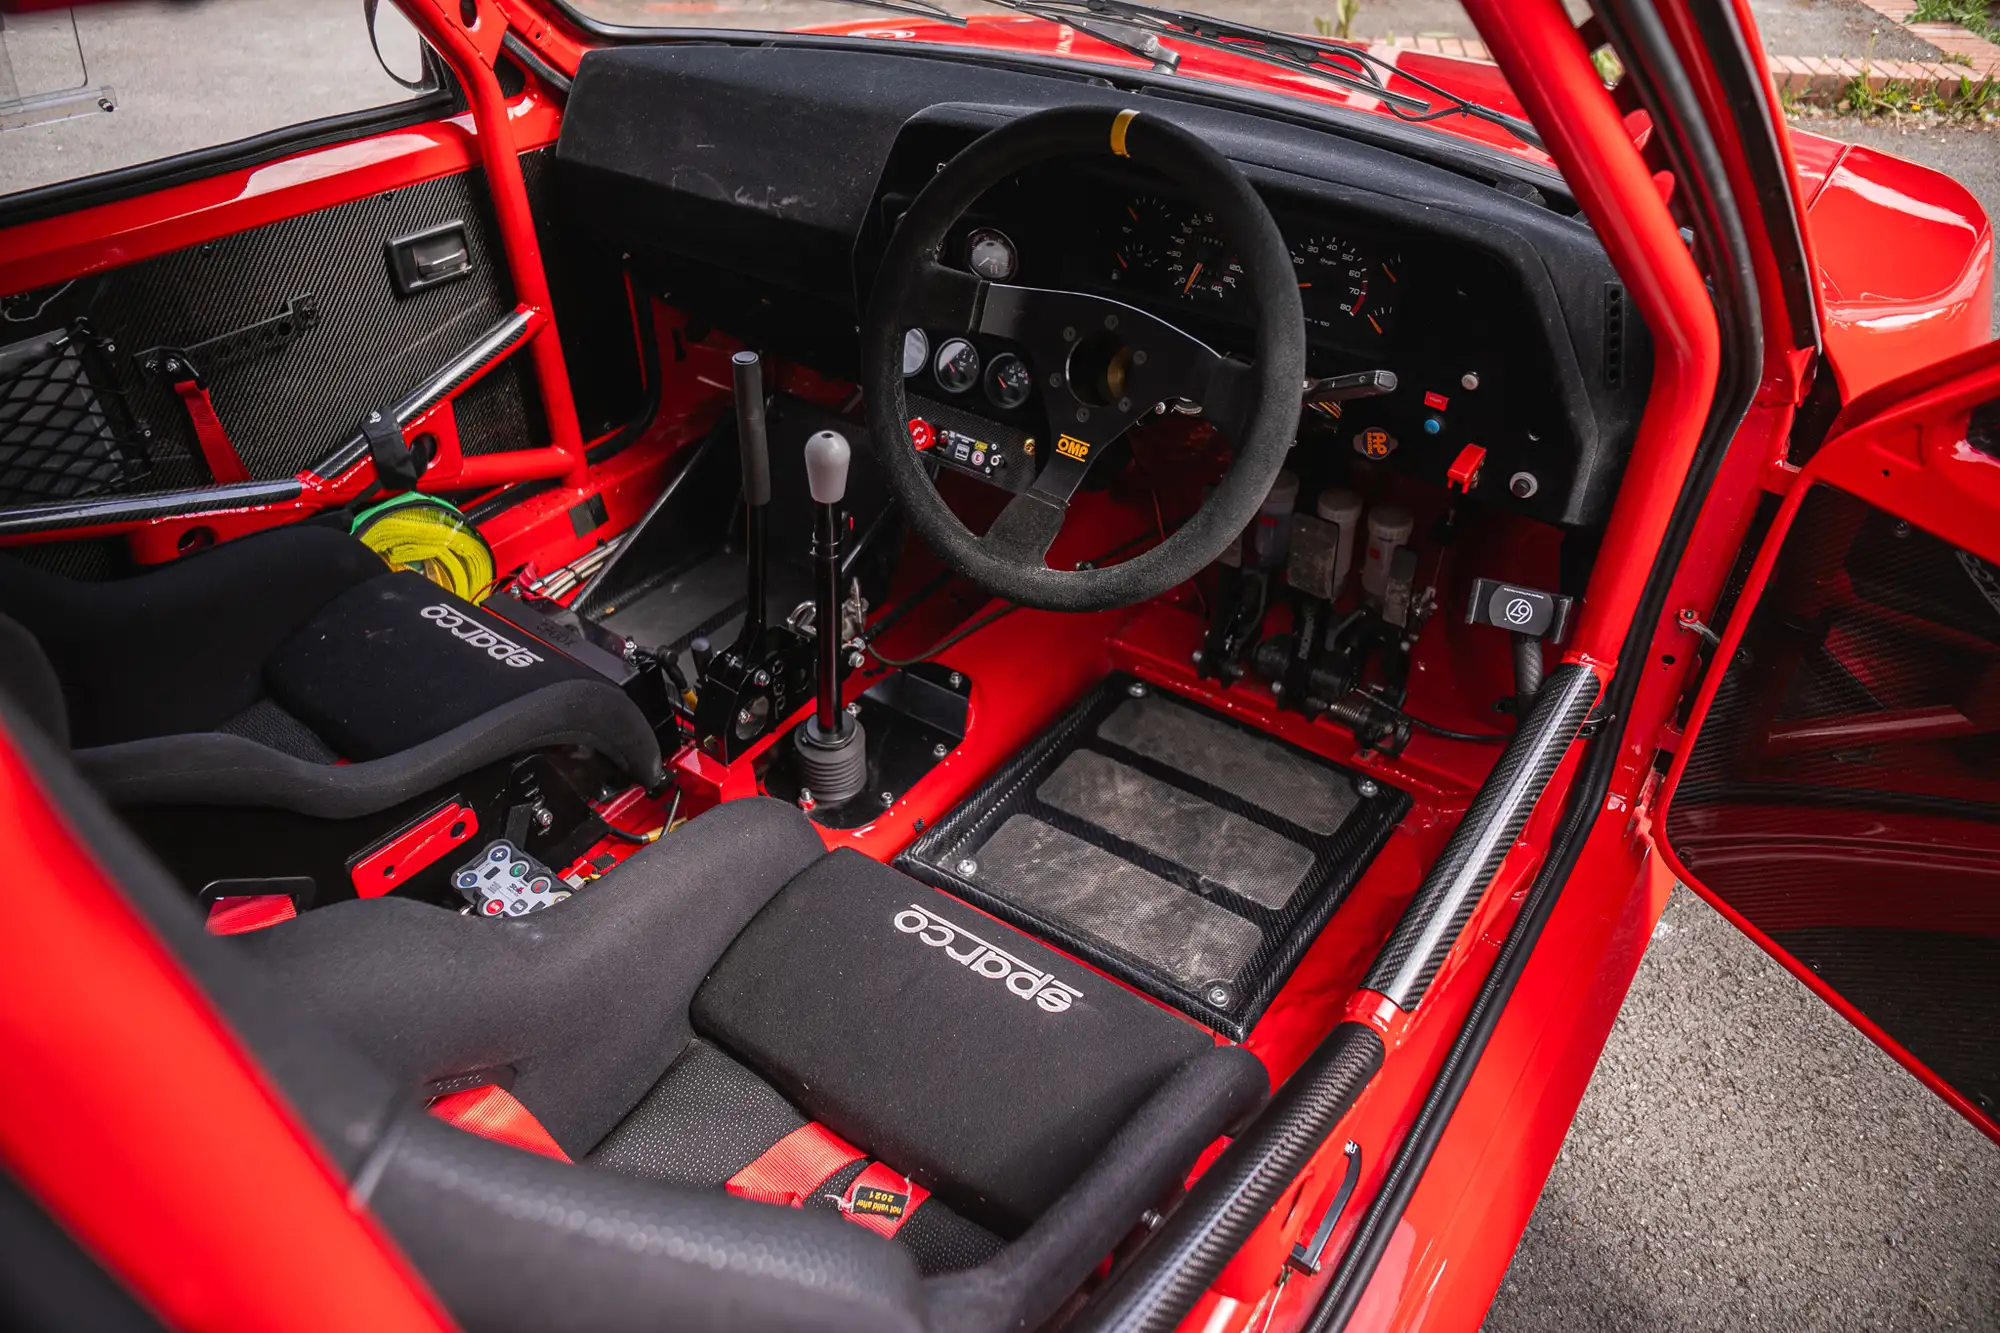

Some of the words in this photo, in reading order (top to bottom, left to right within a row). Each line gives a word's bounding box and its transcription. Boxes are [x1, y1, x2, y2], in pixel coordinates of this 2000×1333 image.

[1307, 245, 1319, 254] 30
[1293, 256, 1305, 265] 20
[1341, 253, 1354, 262] 50
[1348, 269, 1361, 278] 60
[1211, 284, 1223, 293] 140
[1348, 286, 1360, 295] 70
[1339, 303, 1352, 312] 80
[1057, 437, 1090, 458] OMP
[420, 603, 544, 667] sparco
[893, 904, 1084, 1013] sparco
[869, 1190, 894, 1203] 2021
[872, 1202, 889, 1212] valid
[889, 1205, 902, 1214] not
